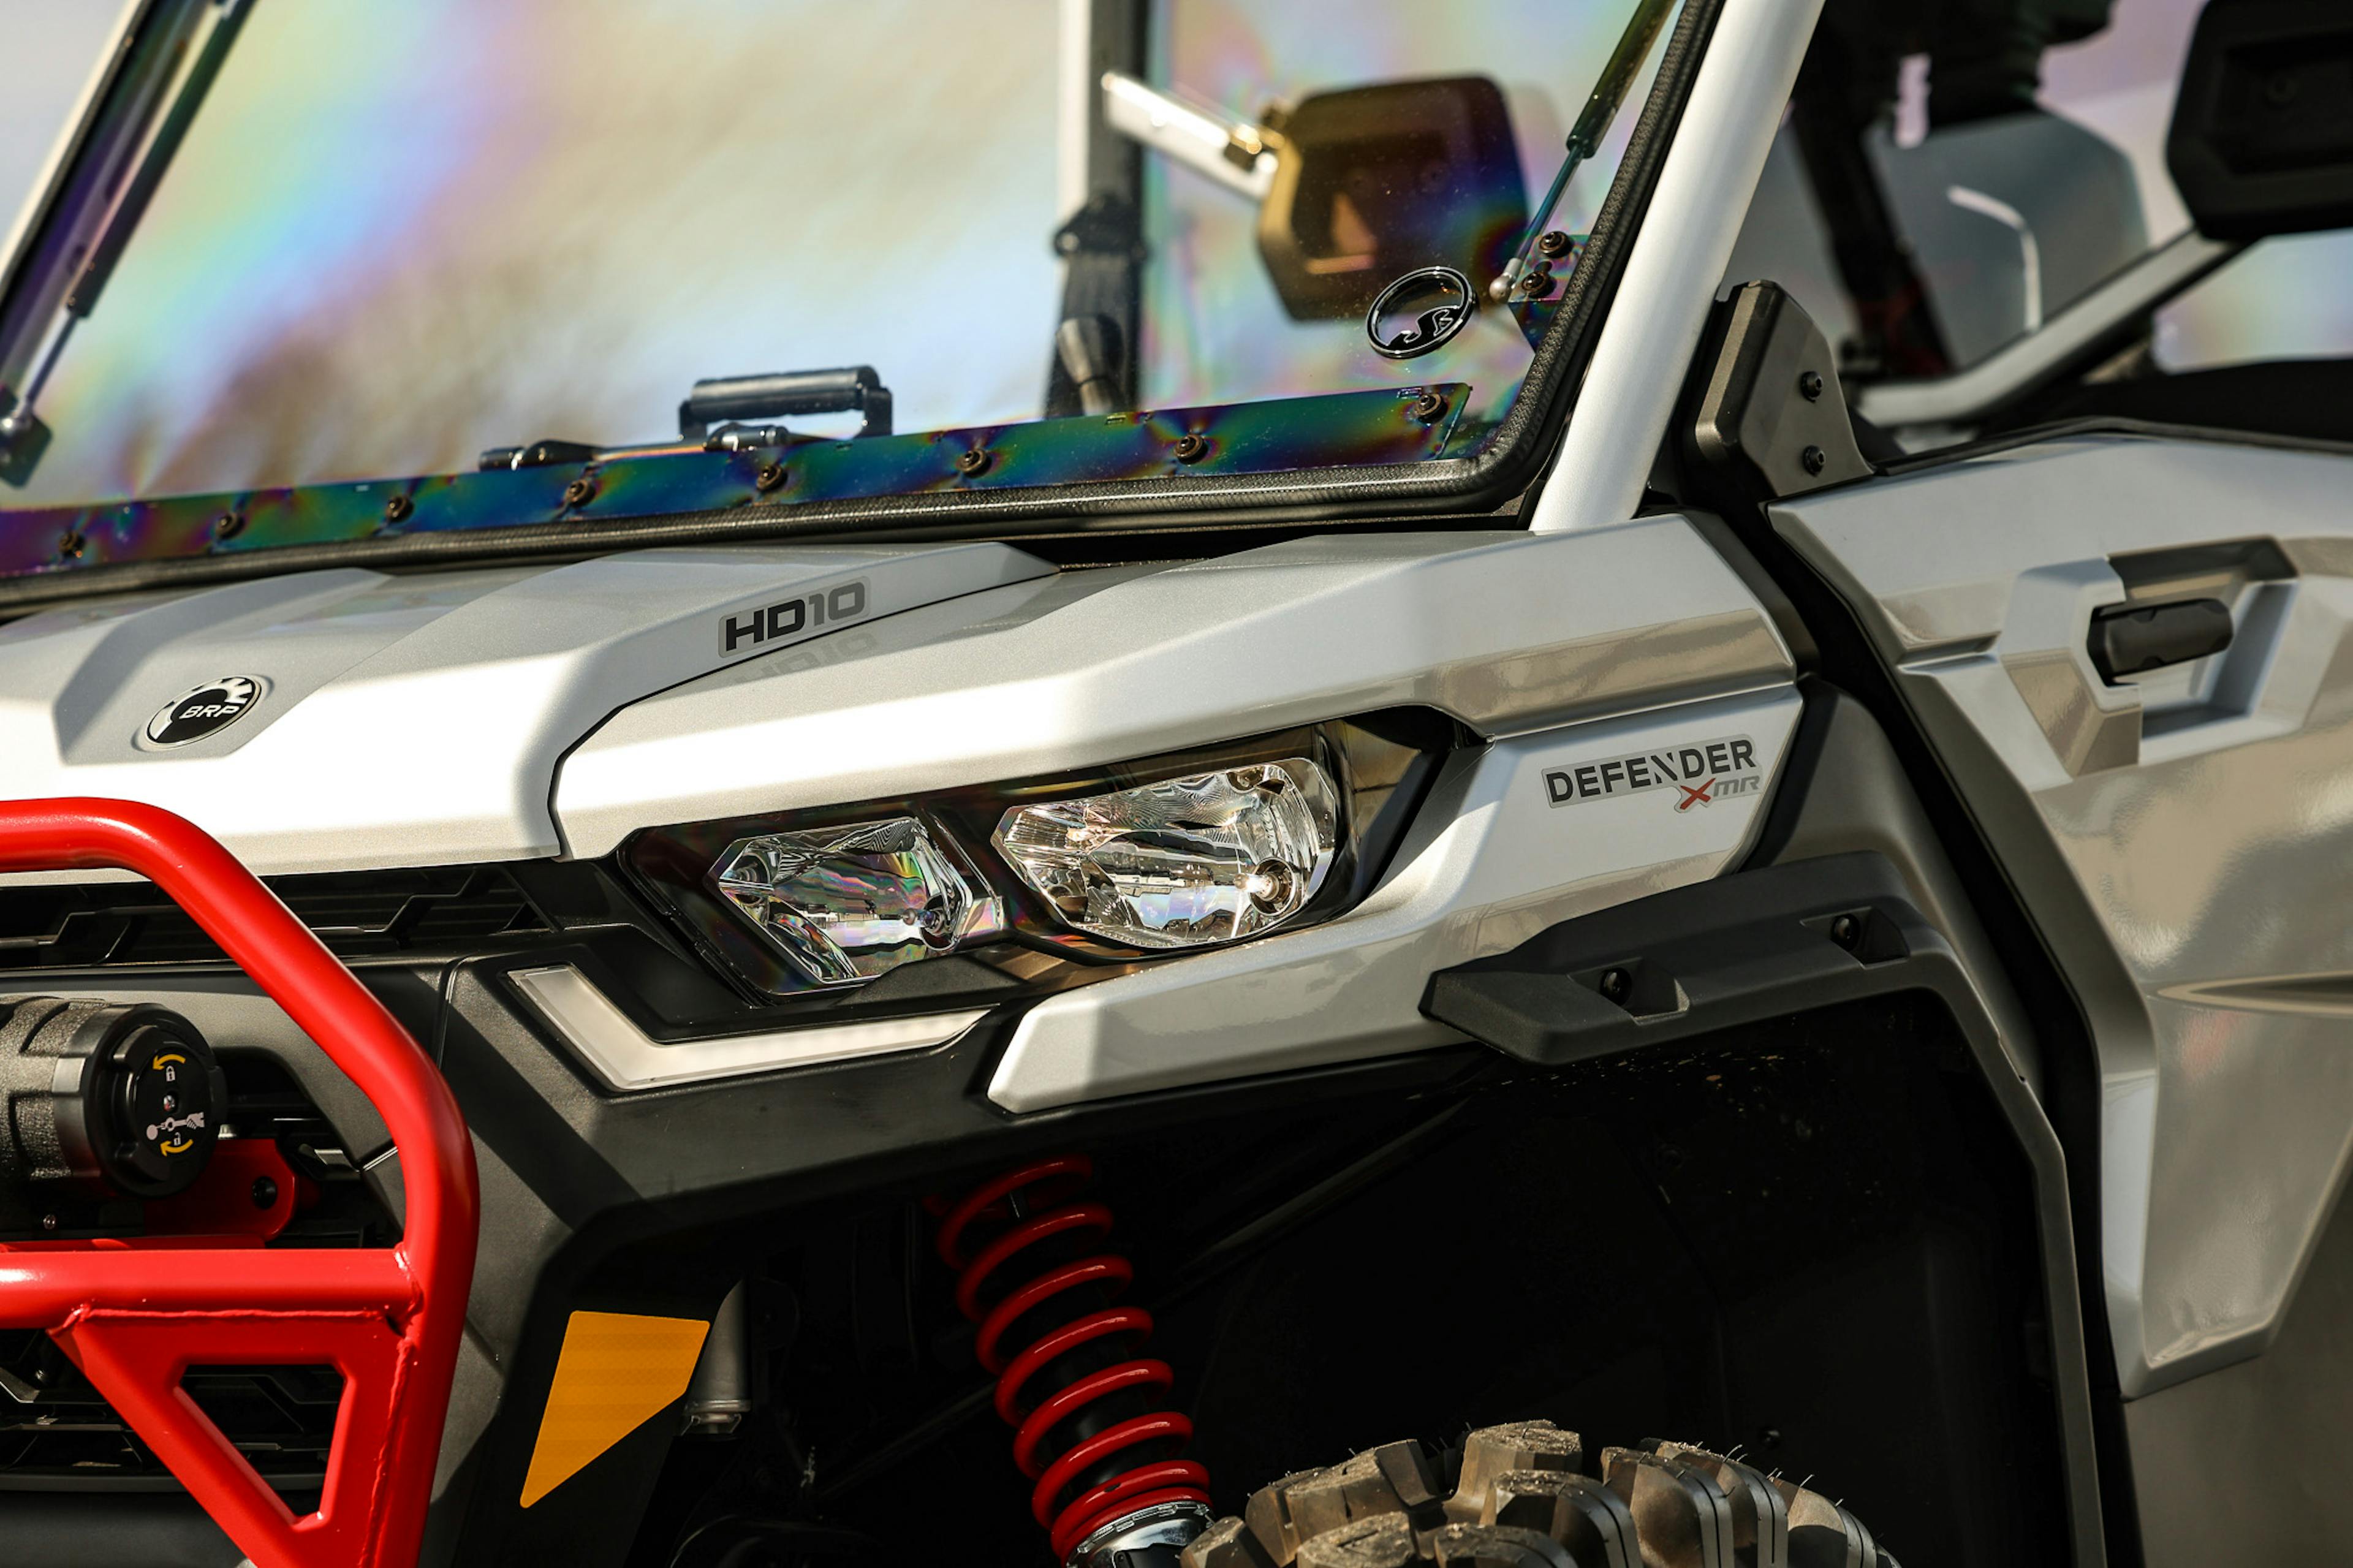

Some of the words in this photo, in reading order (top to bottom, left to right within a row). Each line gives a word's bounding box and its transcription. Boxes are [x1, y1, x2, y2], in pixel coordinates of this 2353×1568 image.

[726, 582, 865, 651] HD10
[179, 705, 240, 719] BRP
[1547, 740, 1756, 803] DEFENDER
